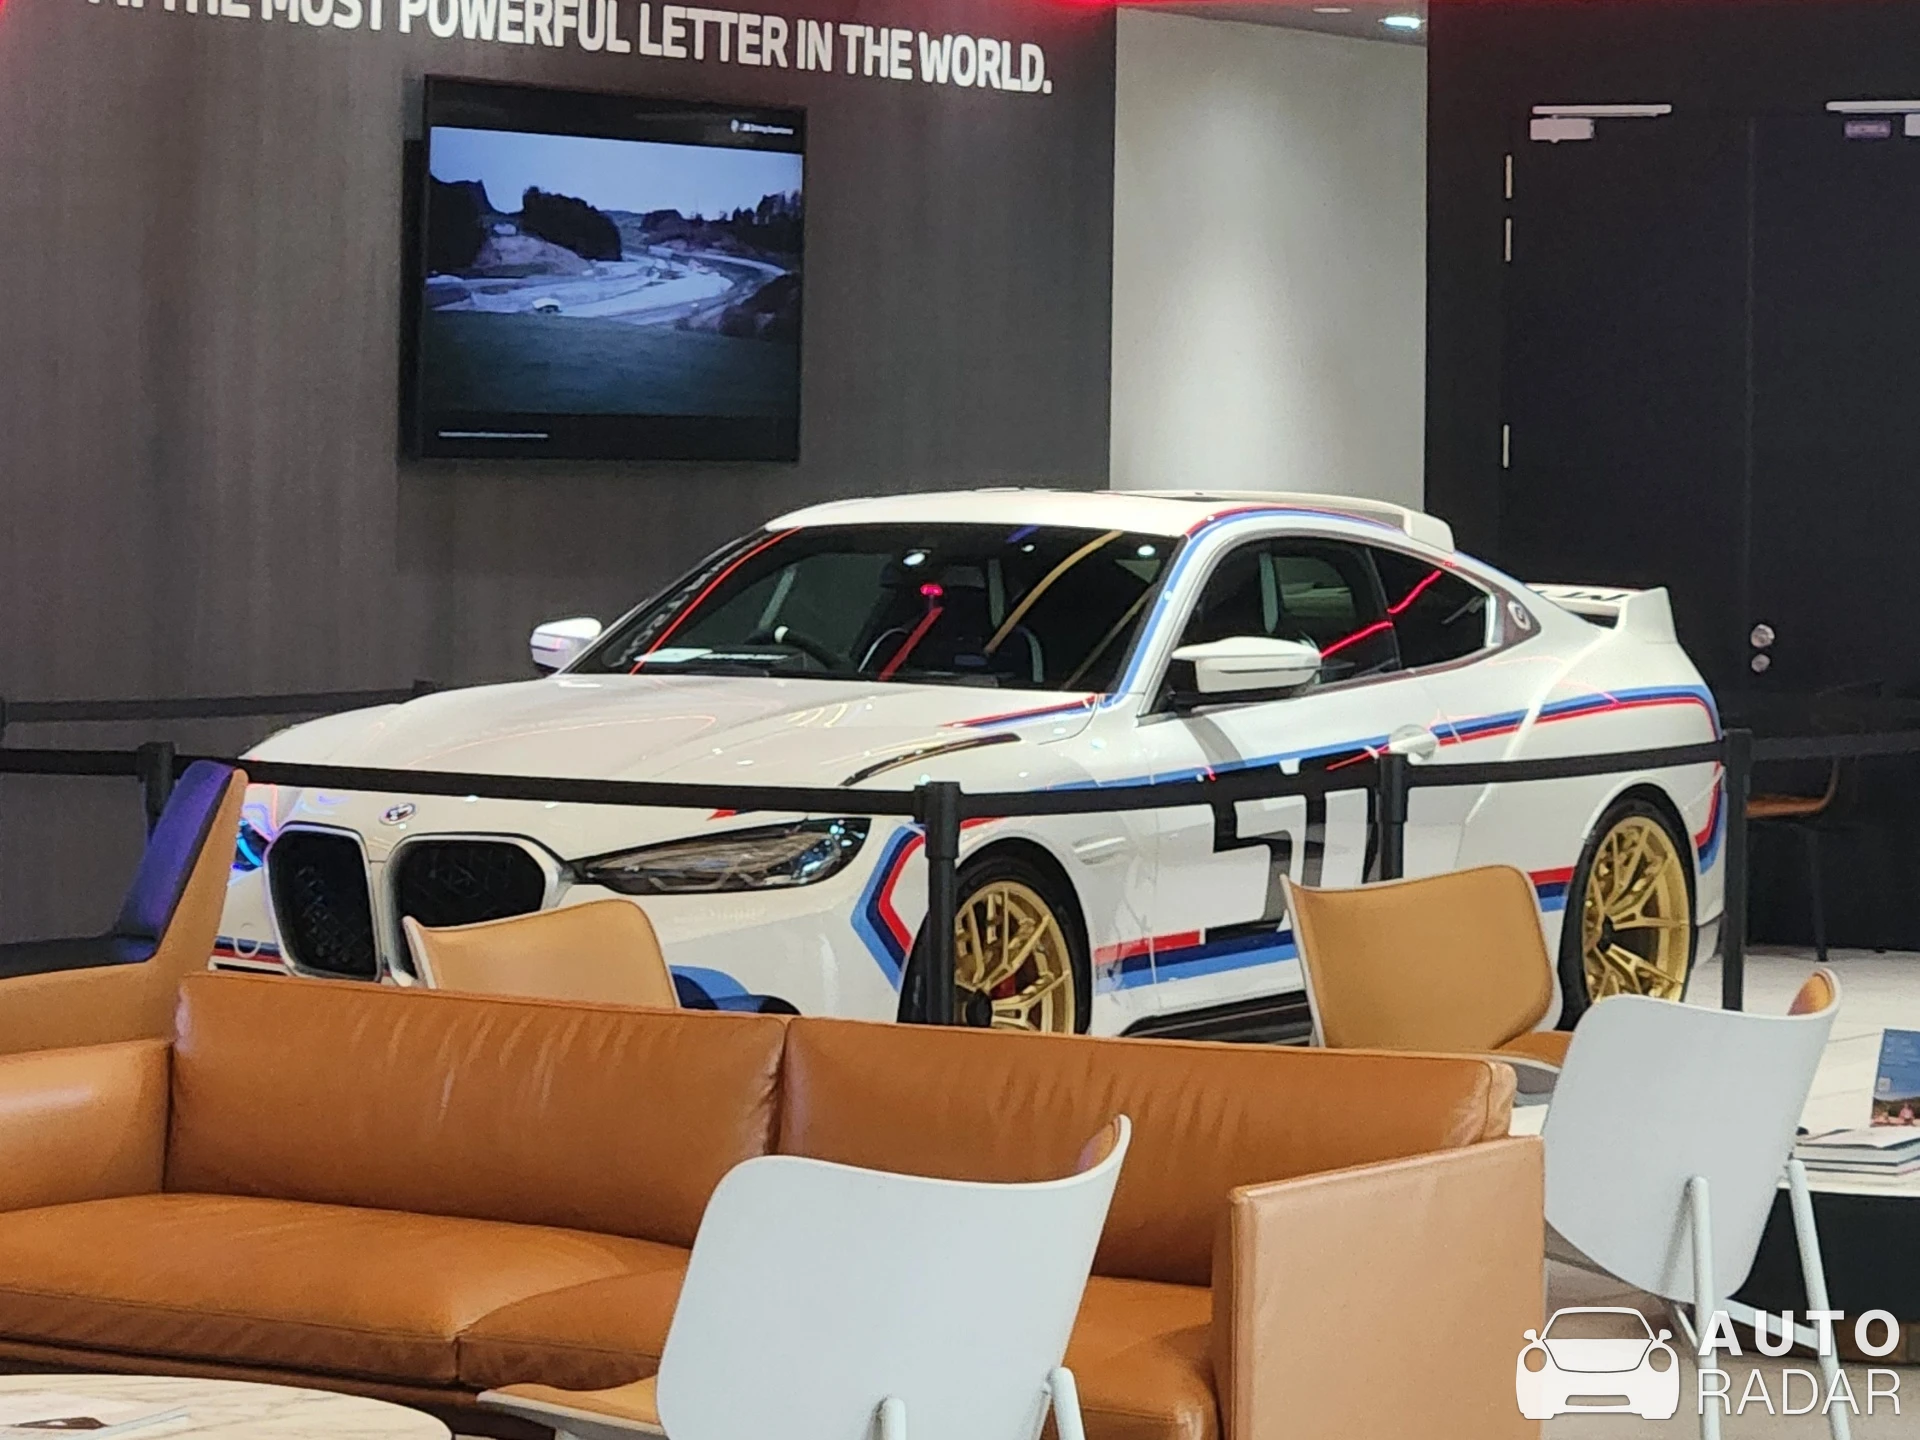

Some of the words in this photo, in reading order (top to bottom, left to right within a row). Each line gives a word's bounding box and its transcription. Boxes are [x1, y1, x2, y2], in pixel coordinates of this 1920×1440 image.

[398, 0, 630, 53] POWERFUL
[639, 3, 788, 68] LETTER
[797, 19, 833, 72] IN
[839, 24, 913, 80] THE
[918, 31, 1052, 94] WORLD.
